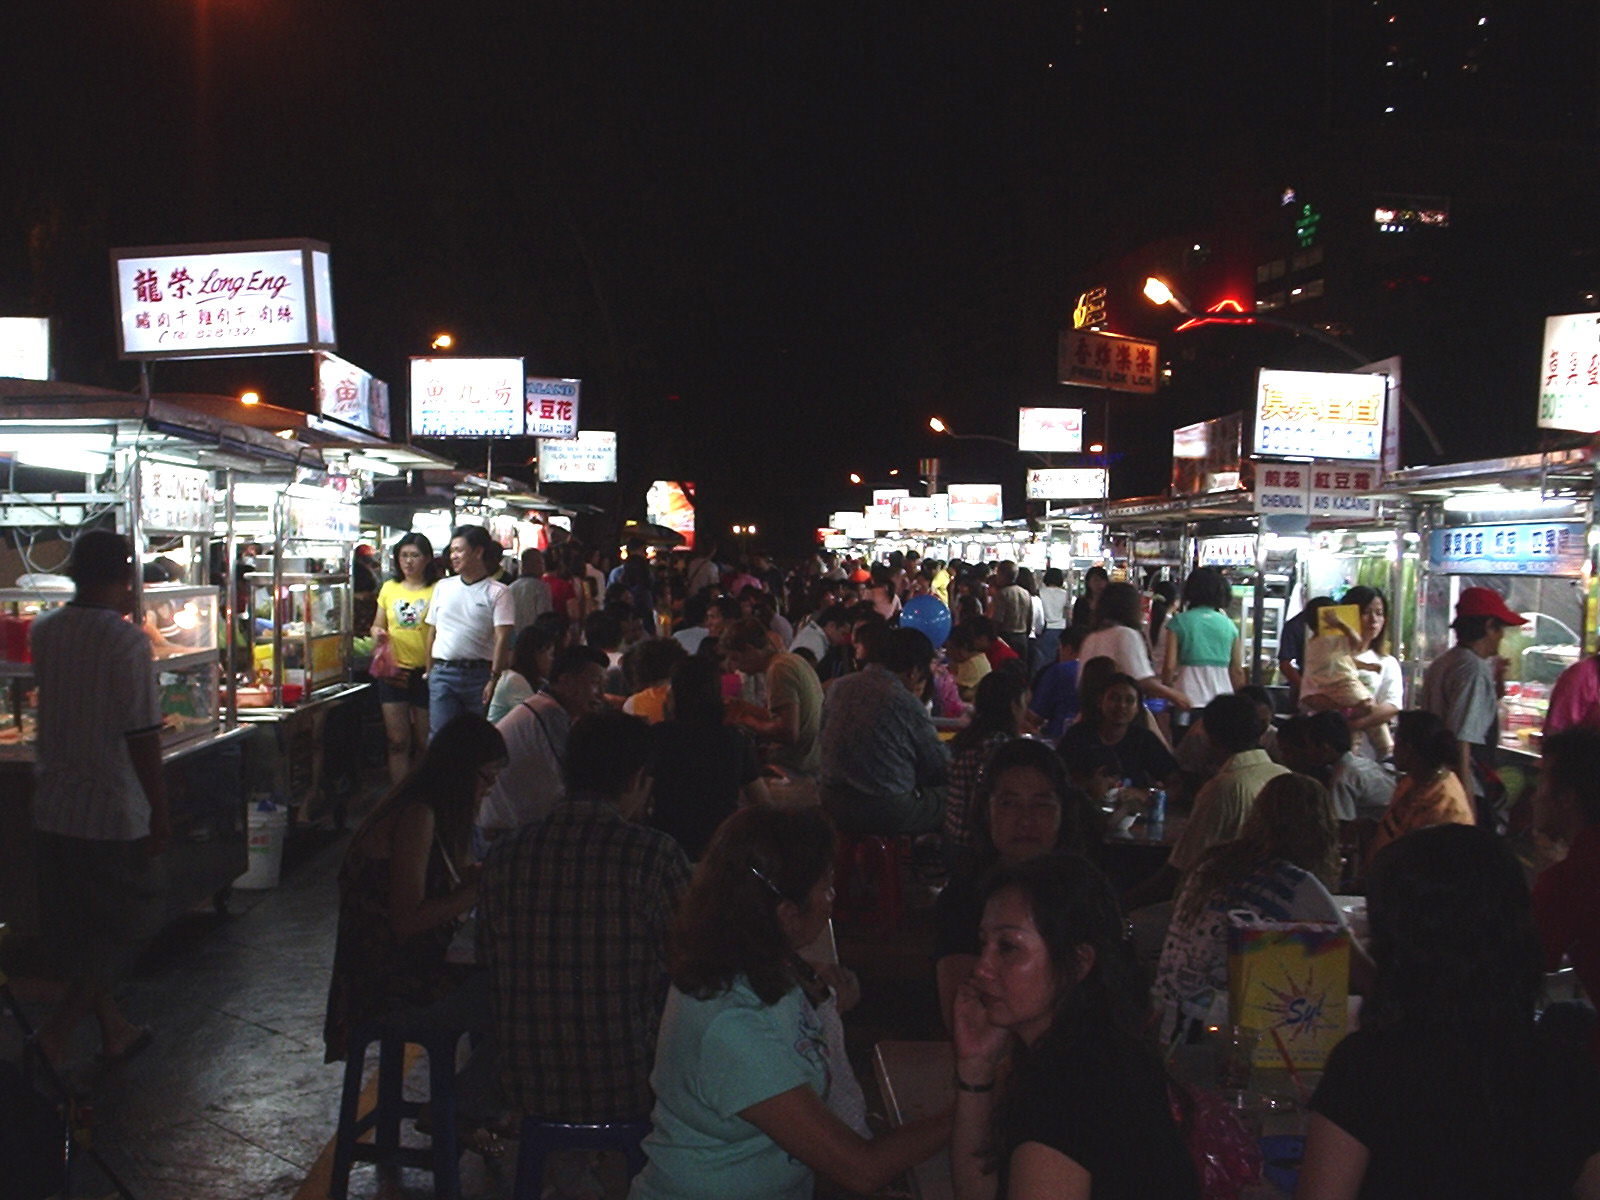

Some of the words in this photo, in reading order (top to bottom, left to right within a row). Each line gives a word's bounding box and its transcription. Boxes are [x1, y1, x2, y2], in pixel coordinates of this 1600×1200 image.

[132, 266, 194, 303] 龍榮
[197, 267, 244, 300] Long
[247, 270, 292, 299] Eng
[1313, 496, 1330, 510] AIS
[1332, 495, 1371, 511] KACANG
